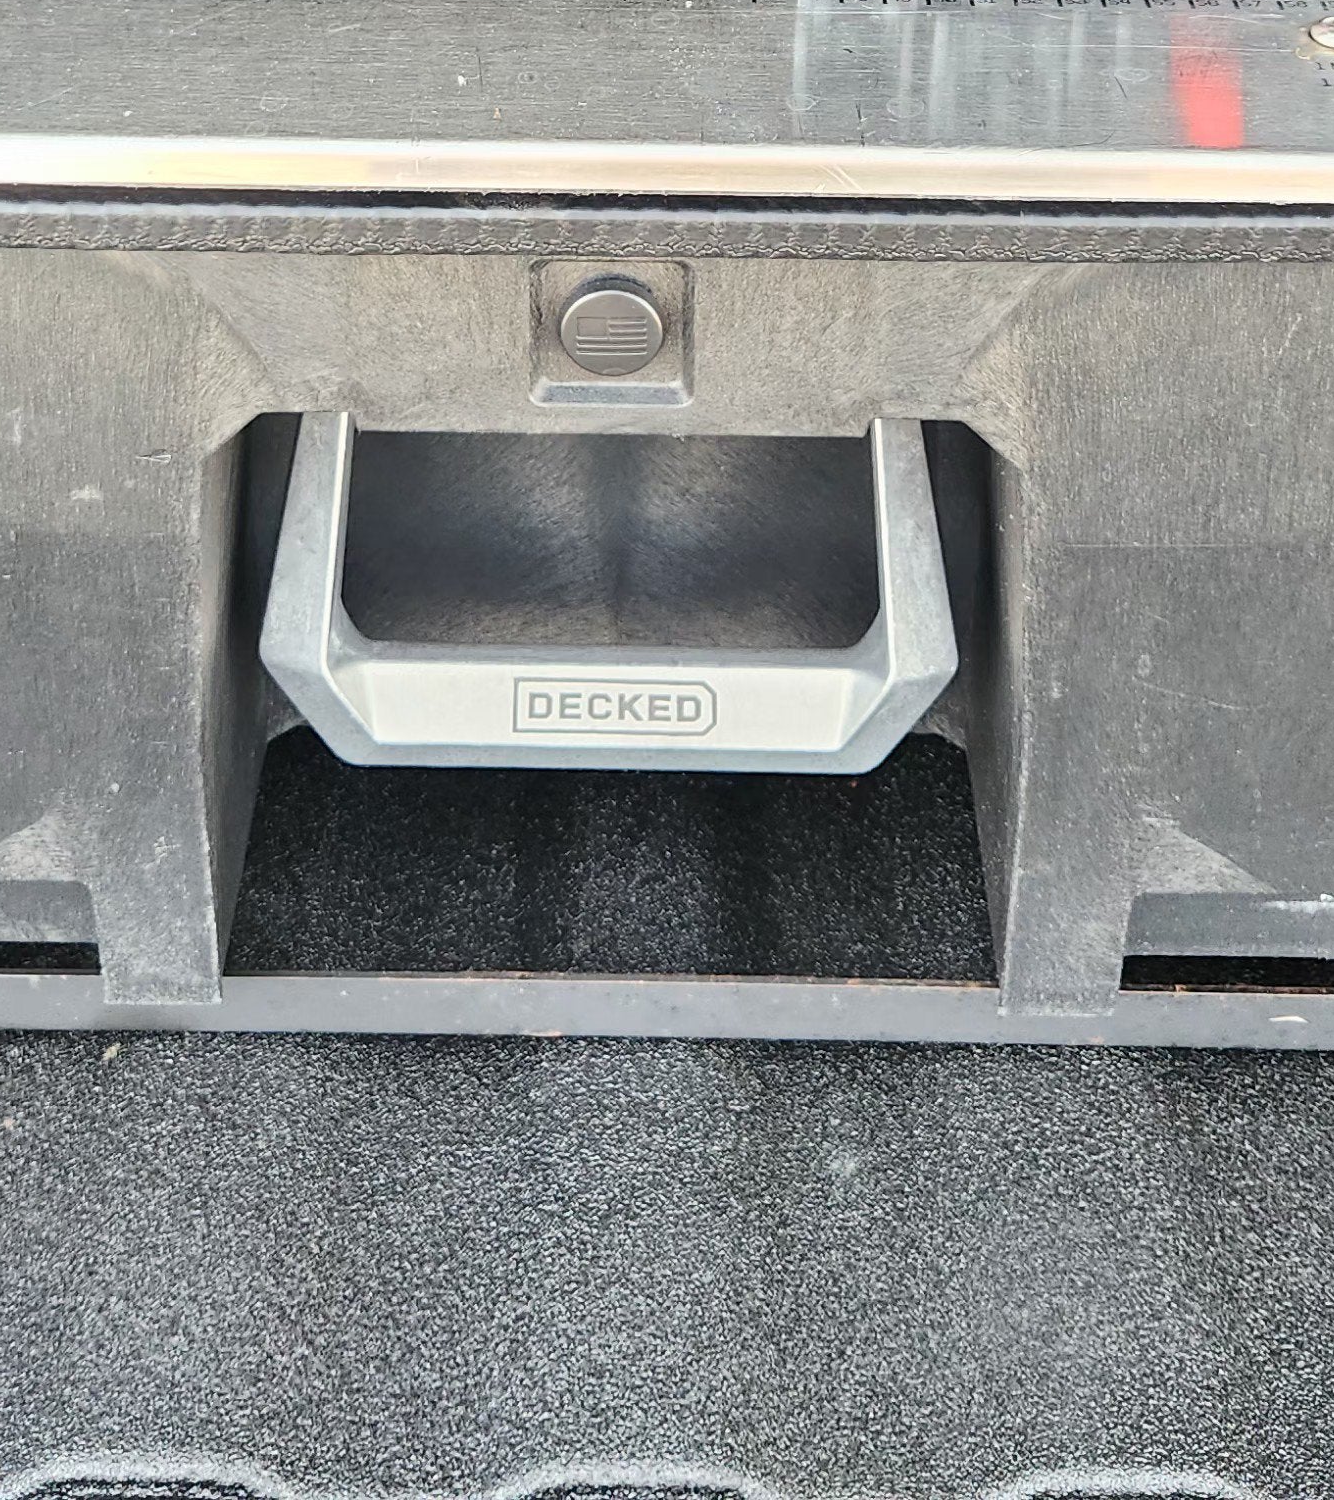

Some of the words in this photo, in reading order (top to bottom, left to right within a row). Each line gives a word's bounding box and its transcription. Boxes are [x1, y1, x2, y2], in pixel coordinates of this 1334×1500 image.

[1315, 62, 1325, 70] 1
[1321, 78, 1332, 87] 1
[528, 692, 702, 722] DECKED
